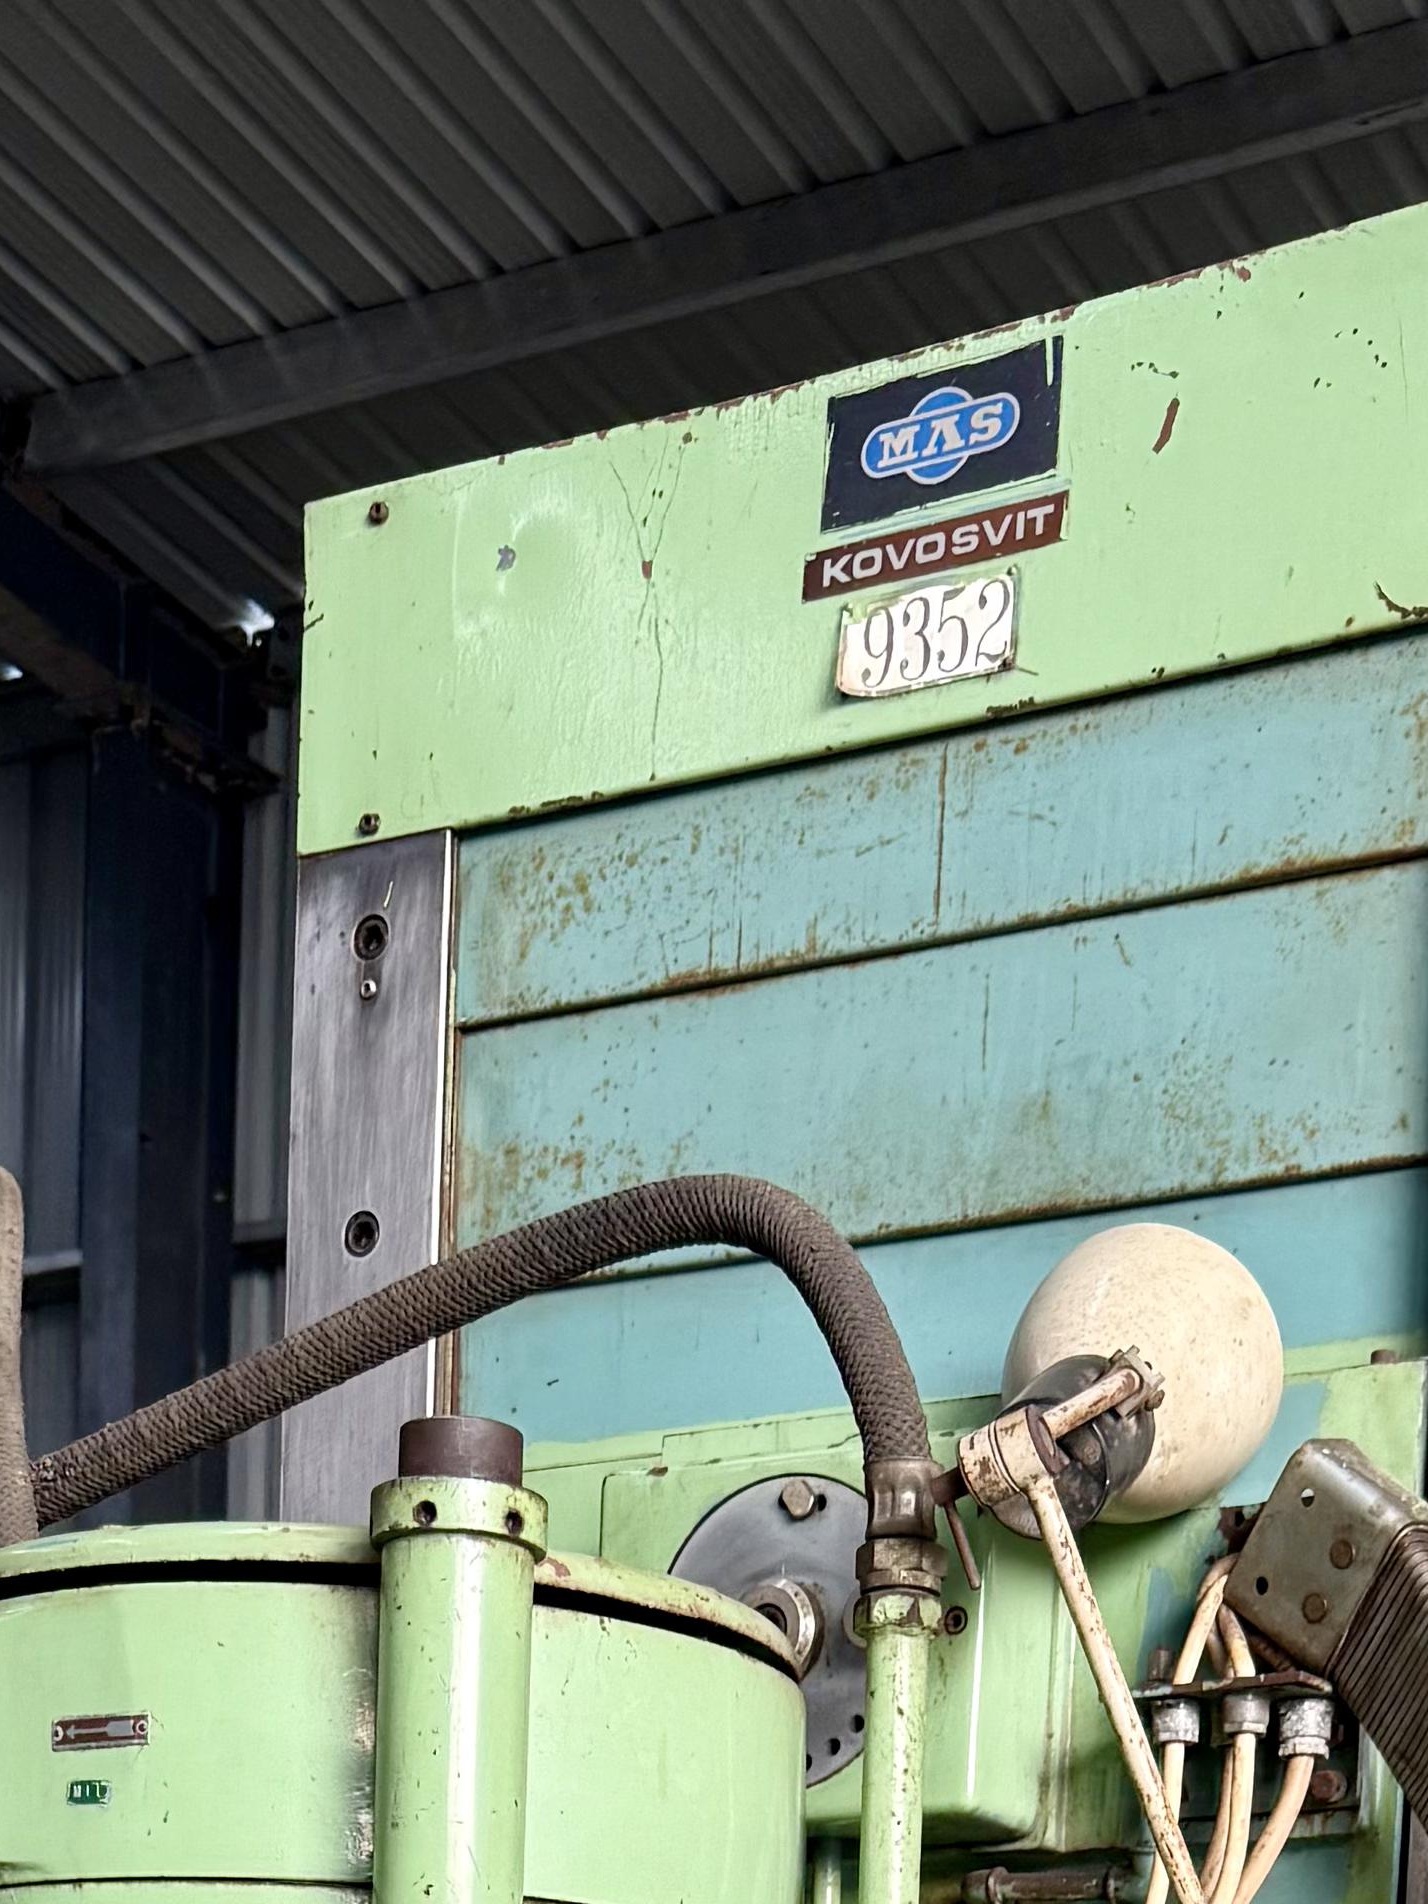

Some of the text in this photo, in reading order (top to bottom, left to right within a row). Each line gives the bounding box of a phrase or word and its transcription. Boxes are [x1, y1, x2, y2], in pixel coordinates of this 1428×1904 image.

[877, 400, 1004, 469] MAS
[822, 503, 1055, 588] KOVOSVIT
[861, 579, 1012, 689] 9352
